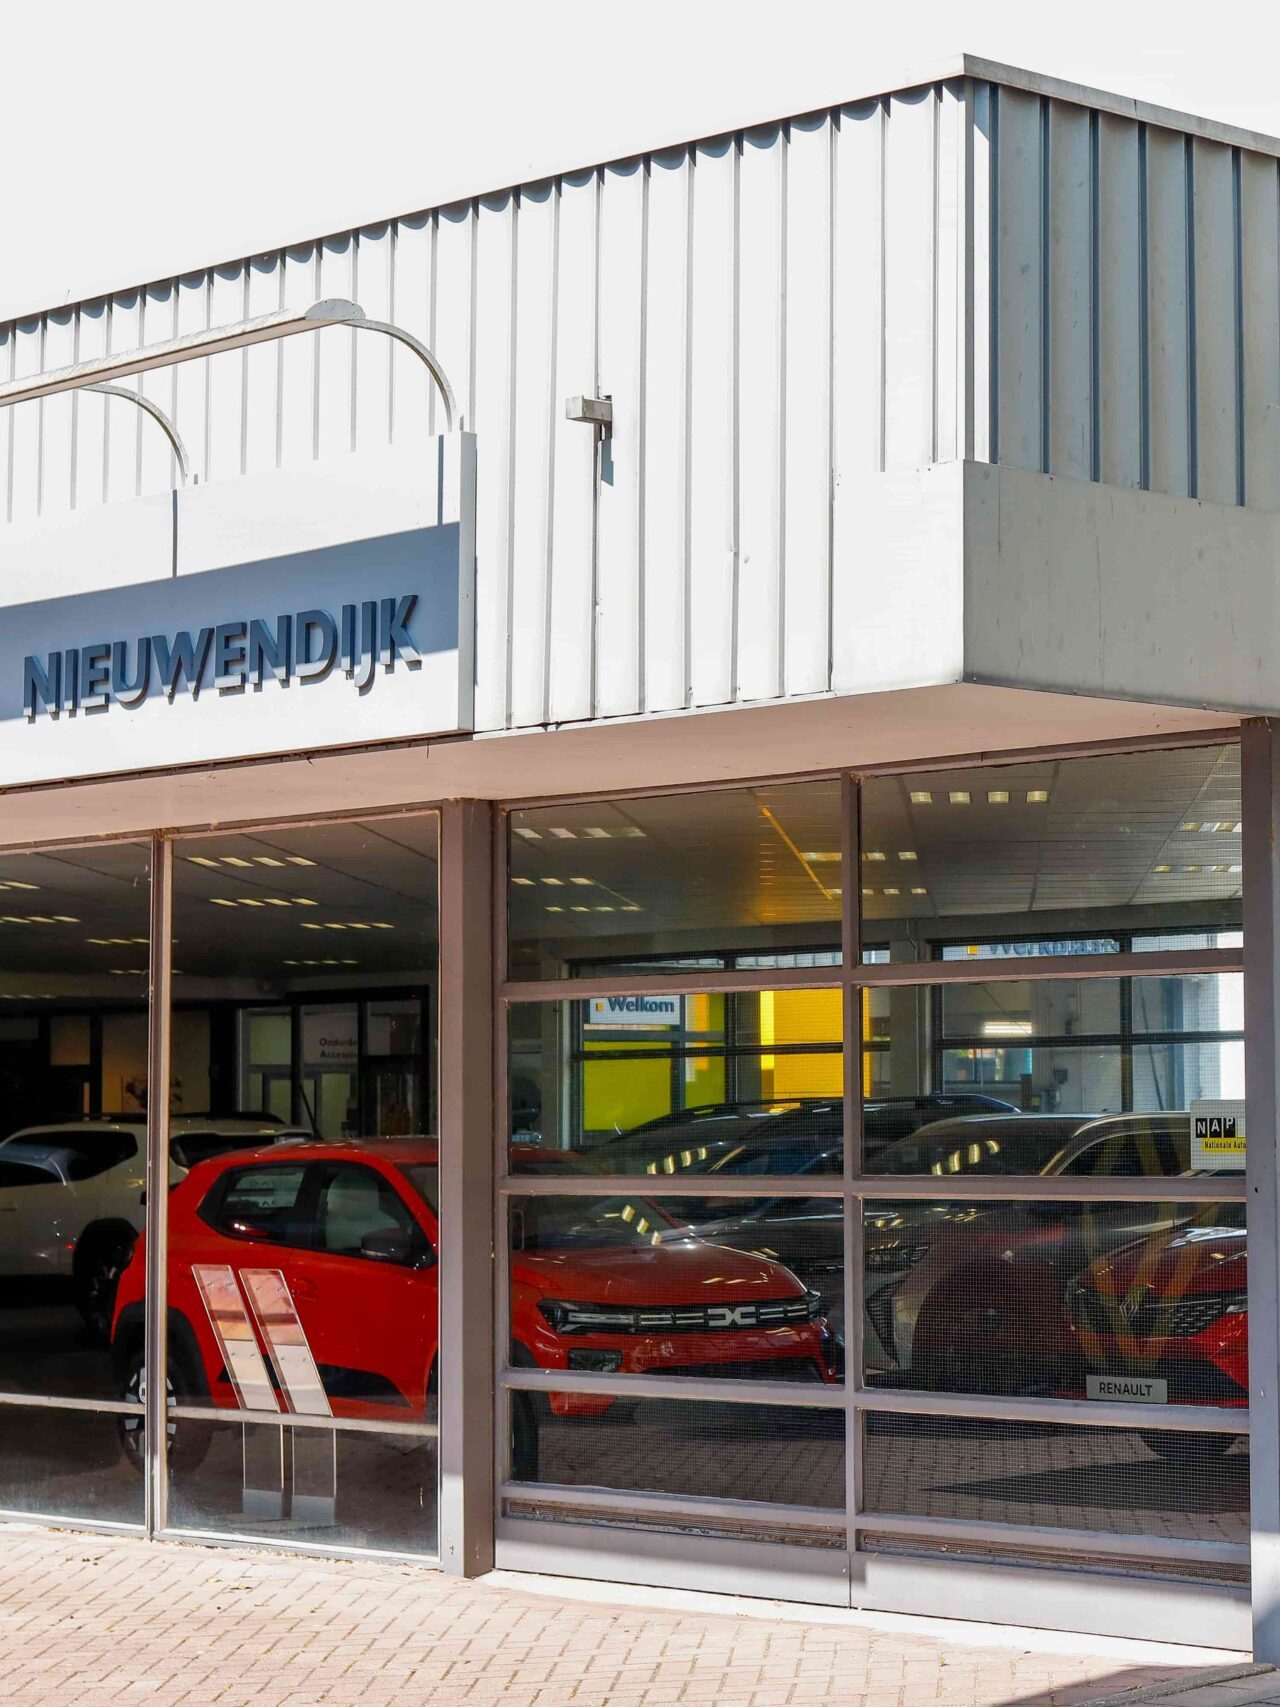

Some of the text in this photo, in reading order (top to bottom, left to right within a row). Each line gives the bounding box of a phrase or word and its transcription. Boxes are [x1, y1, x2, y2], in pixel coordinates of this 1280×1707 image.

[23, 594, 422, 718] NIEUWENDIJK
[607, 996, 675, 1013] Welkom
[1197, 1117, 1234, 1135] NAP
[1204, 1140, 1232, 1149] Nationale
[1099, 1381, 1153, 1397] RENAULT
